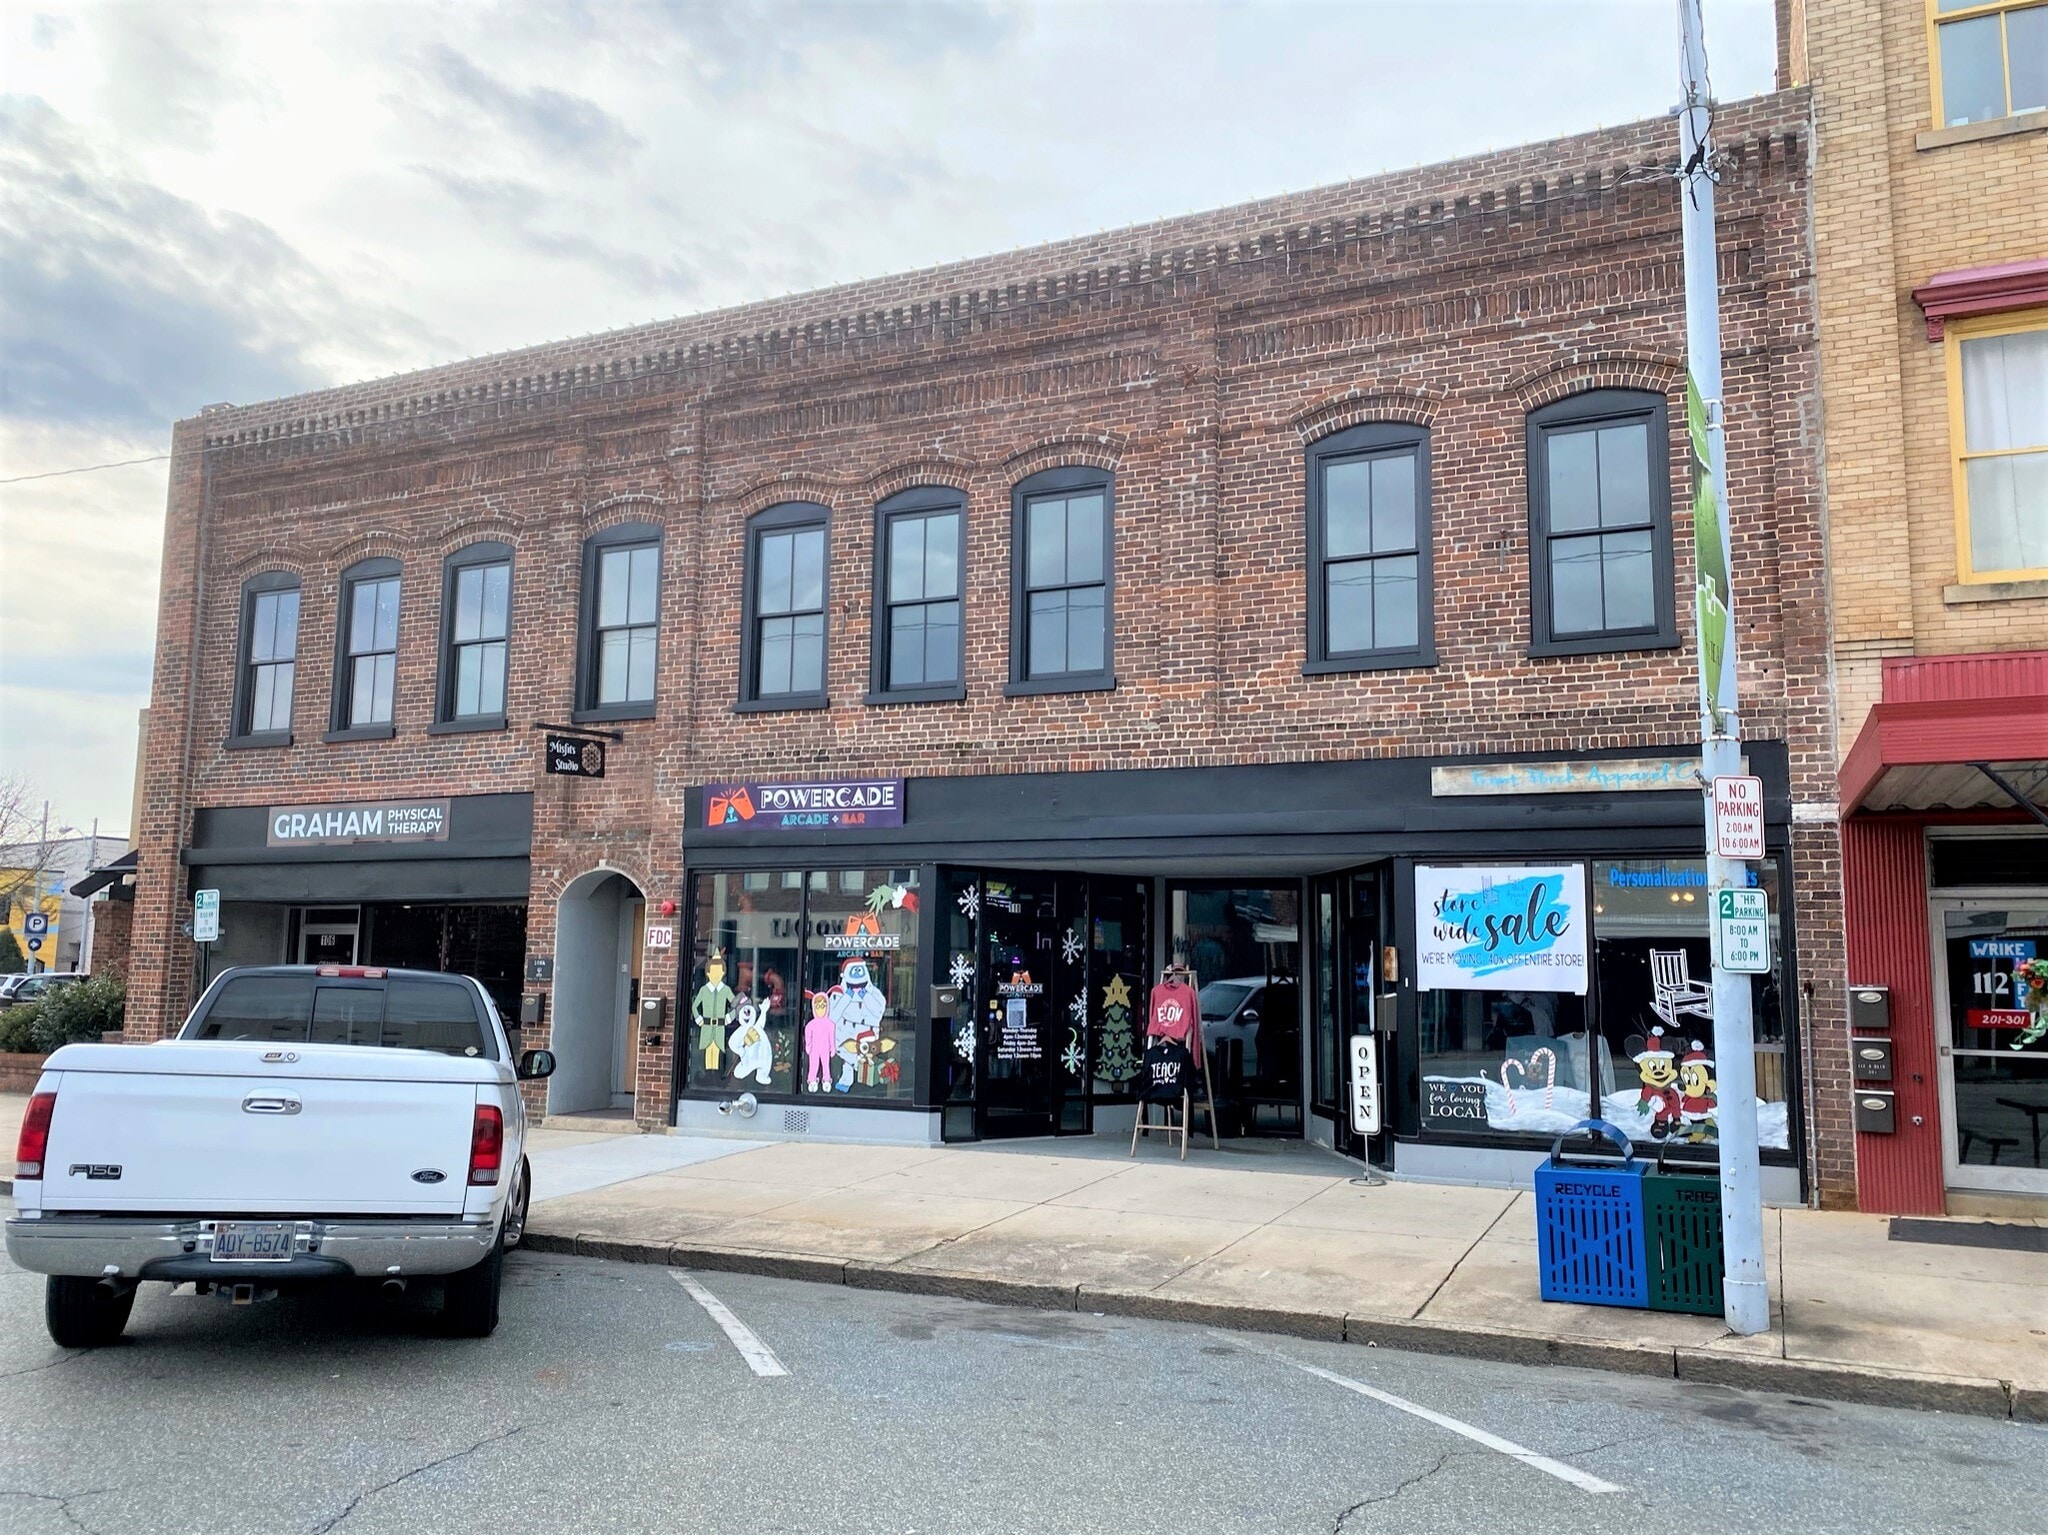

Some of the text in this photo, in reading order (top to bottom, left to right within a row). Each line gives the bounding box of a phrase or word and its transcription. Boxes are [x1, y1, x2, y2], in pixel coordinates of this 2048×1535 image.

[549, 740, 576, 757] Misfits
[555, 759, 579, 771] Studio
[1586, 763, 1671, 790] Apparel
[761, 786, 895, 809] POWERCADE
[1729, 784, 1746, 799] NO
[388, 807, 443, 822] PHYSICAL
[1718, 802, 1759, 817] PARKING
[274, 810, 383, 838] GRAHAM
[781, 814, 829, 826] ARCADE
[842, 812, 865, 824] BAR
[388, 820, 442, 834] THERAPY
[1726, 822, 1753, 833] 2:00 AM
[1722, 837, 1759, 848] TO 6:00 AM
[197, 894, 203, 907] 2
[1433, 888, 1482, 917] store
[1721, 894, 1756, 915] 2 HR
[1484, 883, 1570, 951] sale
[1735, 907, 1764, 918] PARKING
[1434, 914, 1481, 943] wide
[1730, 925, 1758, 935] 8:00 AM
[649, 930, 671, 945] FDC
[825, 936, 899, 948] POWERCADE
[1740, 938, 1748, 948] TO
[1730, 951, 1759, 961] 6:00 PM
[1971, 942, 2025, 956] WRIKE
[1421, 952, 1445, 964] WE'RE
[1506, 954, 1523, 965] OFF
[1524, 954, 1553, 966] ENTIRE
[1555, 954, 1584, 967] STORE!
[1973, 971, 2009, 994] 112
[1982, 1014, 2025, 1025] 201-301
[1151, 1062, 1181, 1079] TEACH
[1358, 1046, 1371, 1119] OPEN
[1429, 1083, 1485, 1094] WE YOU
[1429, 1092, 1481, 1108] for loving
[1429, 1105, 1486, 1119] LOCAL
[1555, 1183, 1621, 1198] RECYCLE
[217, 1234, 290, 1252] ADY-8574
